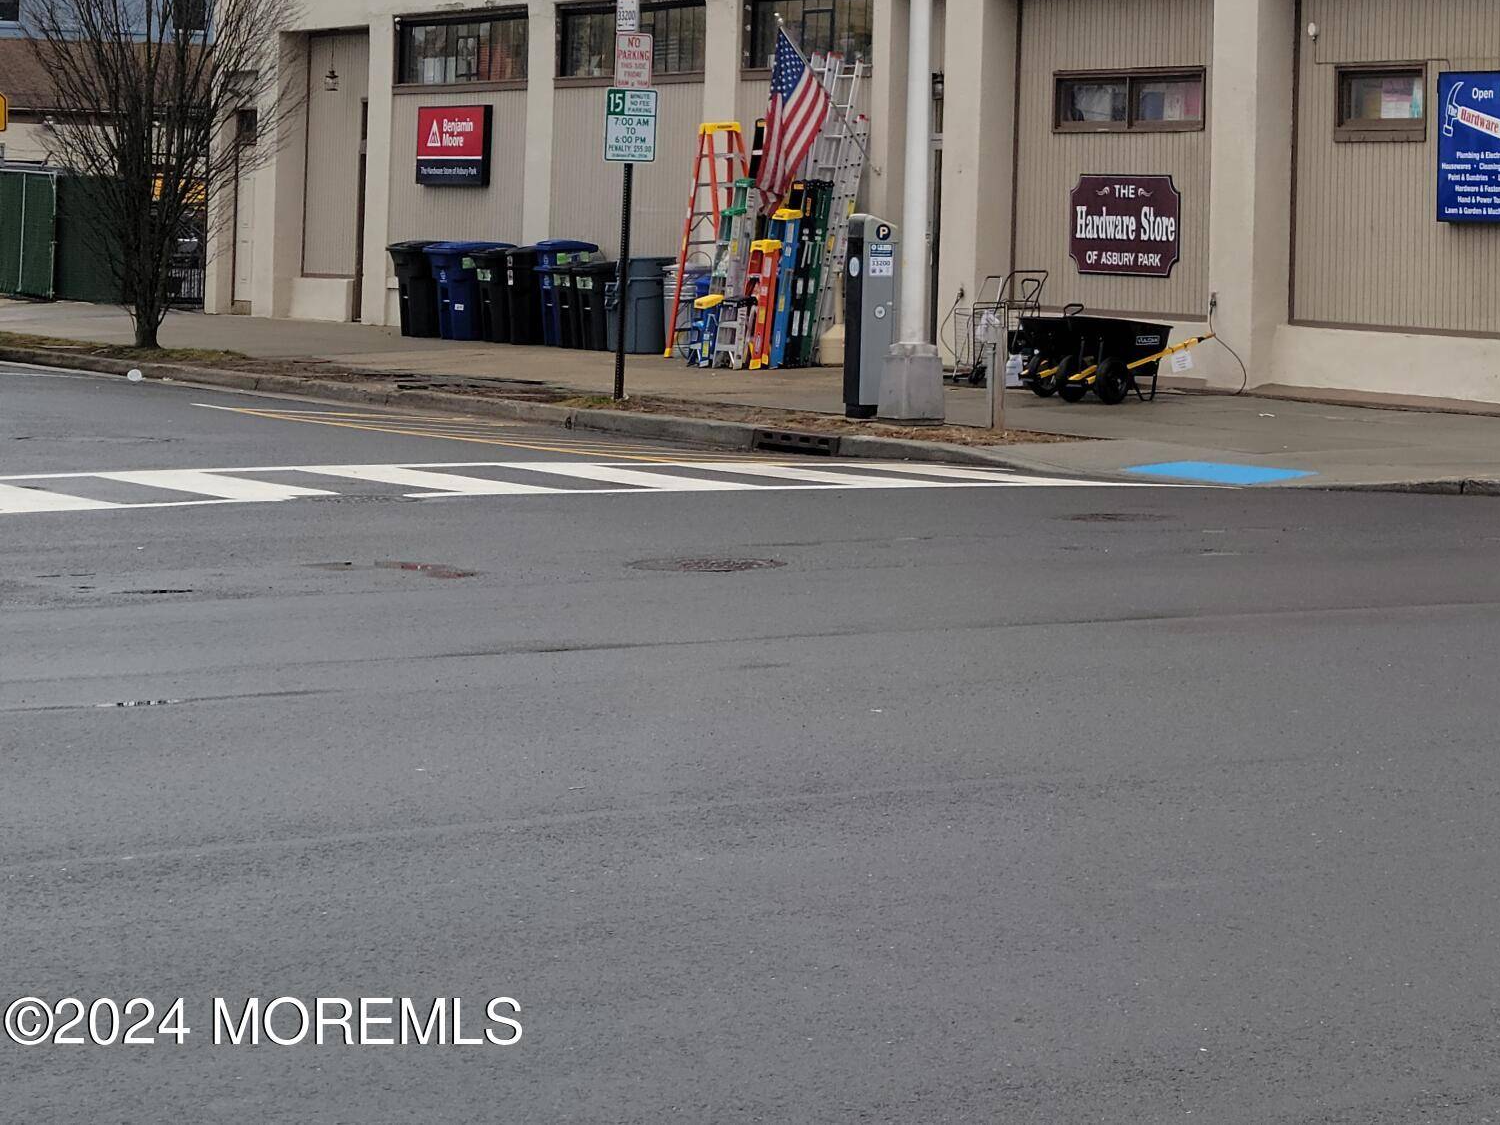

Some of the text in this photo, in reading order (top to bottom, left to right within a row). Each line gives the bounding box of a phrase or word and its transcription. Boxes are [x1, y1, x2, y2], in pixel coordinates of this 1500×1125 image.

[617, 10, 635, 21] 33200
[628, 37, 641, 48] NO
[617, 50, 650, 61] PARKING
[1472, 87, 1494, 102] Open
[609, 93, 624, 112] 15
[443, 118, 473, 135] Benjamin
[613, 117, 650, 126] 7:00 AM
[1460, 107, 1499, 133] Hardware
[626, 127, 636, 135] TO
[442, 133, 464, 147] Moore
[1456, 151, 1480, 161] Plumbing
[1113, 184, 1136, 198] THE
[1476, 196, 1492, 204] Power
[1463, 207, 1482, 215] Garden
[1075, 205, 1176, 242] Hardware Store
[880, 226, 889, 239] P
[1086, 251, 1162, 267] OF ASBURY PARK
